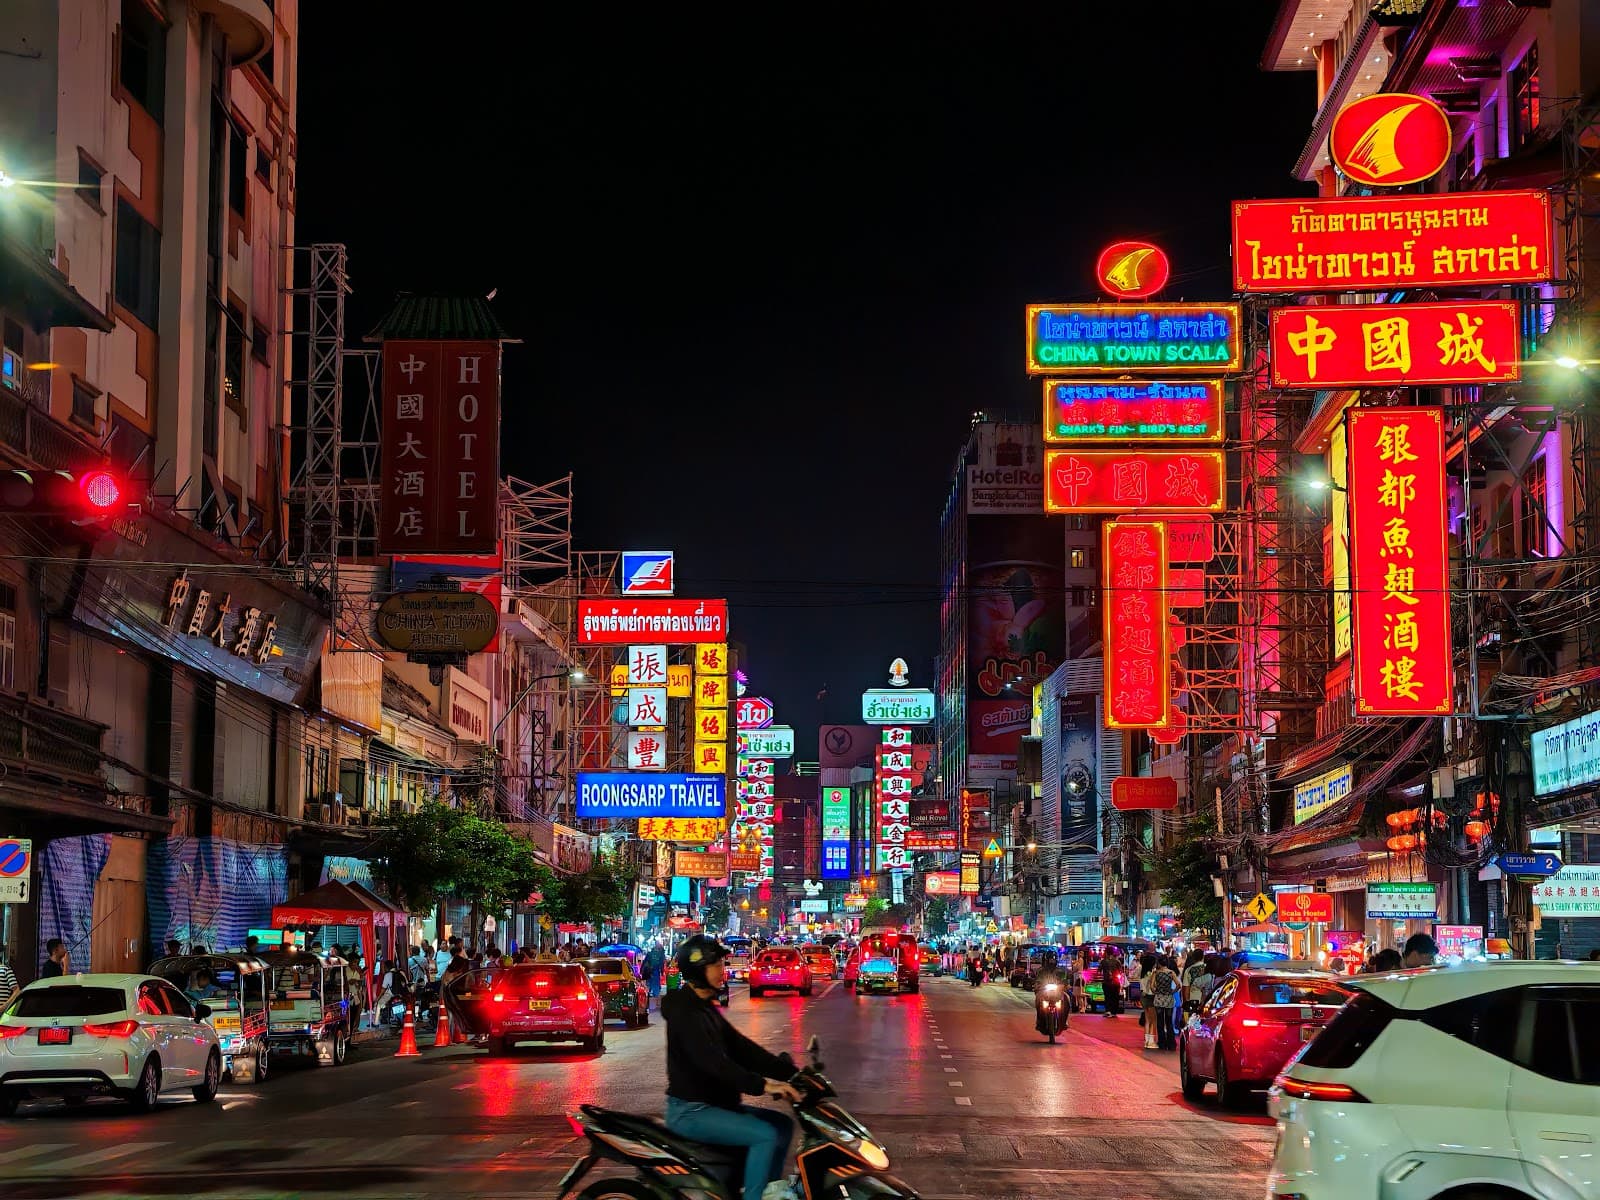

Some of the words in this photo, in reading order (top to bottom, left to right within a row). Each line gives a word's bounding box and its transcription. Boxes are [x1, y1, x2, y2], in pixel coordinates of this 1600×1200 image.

[1291, 207, 1489, 236] ภัตตาคารหูฉลาม
[1245, 239, 1416, 280] ไชน่าทาวน์
[1432, 234, 1540, 276] สกาล่า
[1039, 312, 1149, 340] ไชน่าทาวน์
[1158, 312, 1229, 339] สกาล่า
[1039, 345, 1099, 362] CHINA
[1103, 345, 1161, 362] TOWN
[1166, 344, 1230, 362] SCALA
[1287, 313, 1498, 379] 中國城
[393, 353, 428, 538] 中國大酒店
[457, 356, 482, 537] HOTEL
[1058, 424, 1105, 435] SHARK'S
[1139, 424, 1176, 434] BIRD'S
[1178, 424, 1208, 434] NEST
[1056, 457, 1208, 506] 中國城
[1374, 423, 1425, 703] 銀都魚翅酒樓
[383, 612, 438, 631] CHINA
[443, 612, 492, 632] TOWN
[583, 602, 721, 641] รุ่งทรัพย์การท่องเที่ยว
[1114, 530, 1158, 721] 銀都魚翅酒樓
[867, 699, 931, 718] ฮั่วเซ่งเฮง
[581, 783, 665, 808] ROONGSARP
[670, 783, 721, 808] TRAVEL
[889, 729, 907, 867] 和成興大金行
[1545, 858, 1553, 869] 2
[1303, 909, 1327, 917] Hostel
